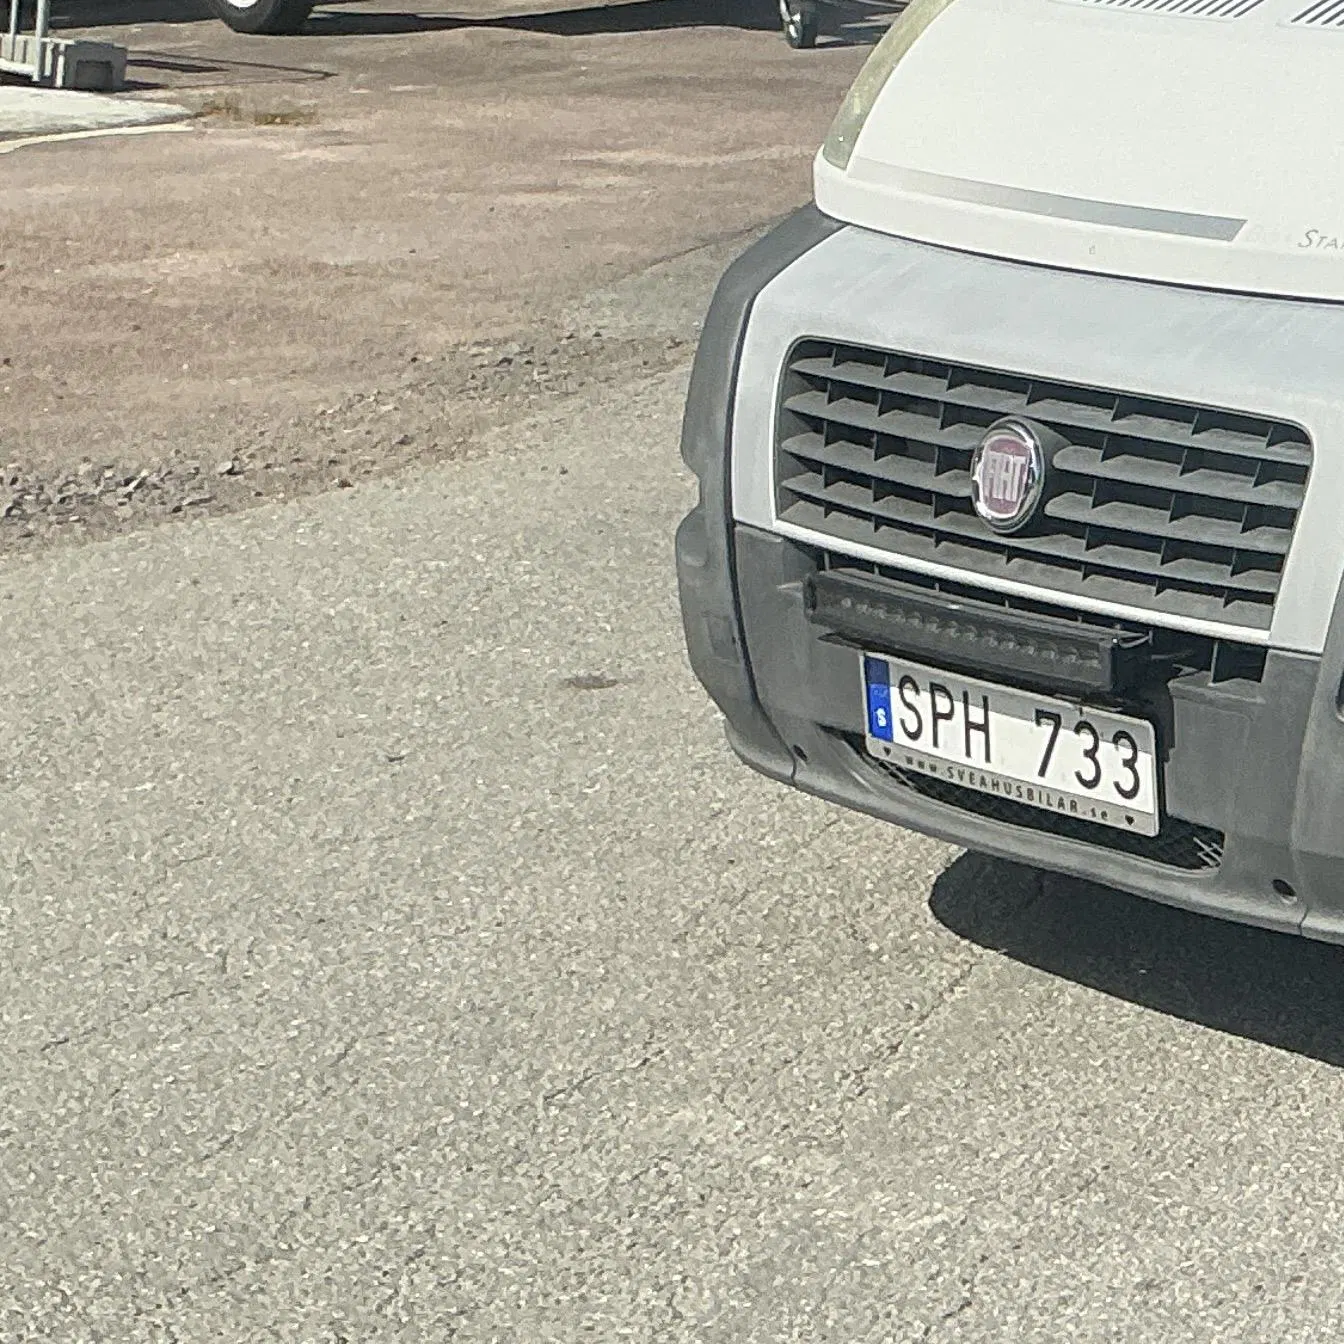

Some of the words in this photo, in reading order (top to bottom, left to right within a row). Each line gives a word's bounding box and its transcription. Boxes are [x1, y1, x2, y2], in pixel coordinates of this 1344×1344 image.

[983, 450, 1028, 504] FIAT
[898, 674, 992, 764] SPH
[1033, 708, 1141, 800] 733
